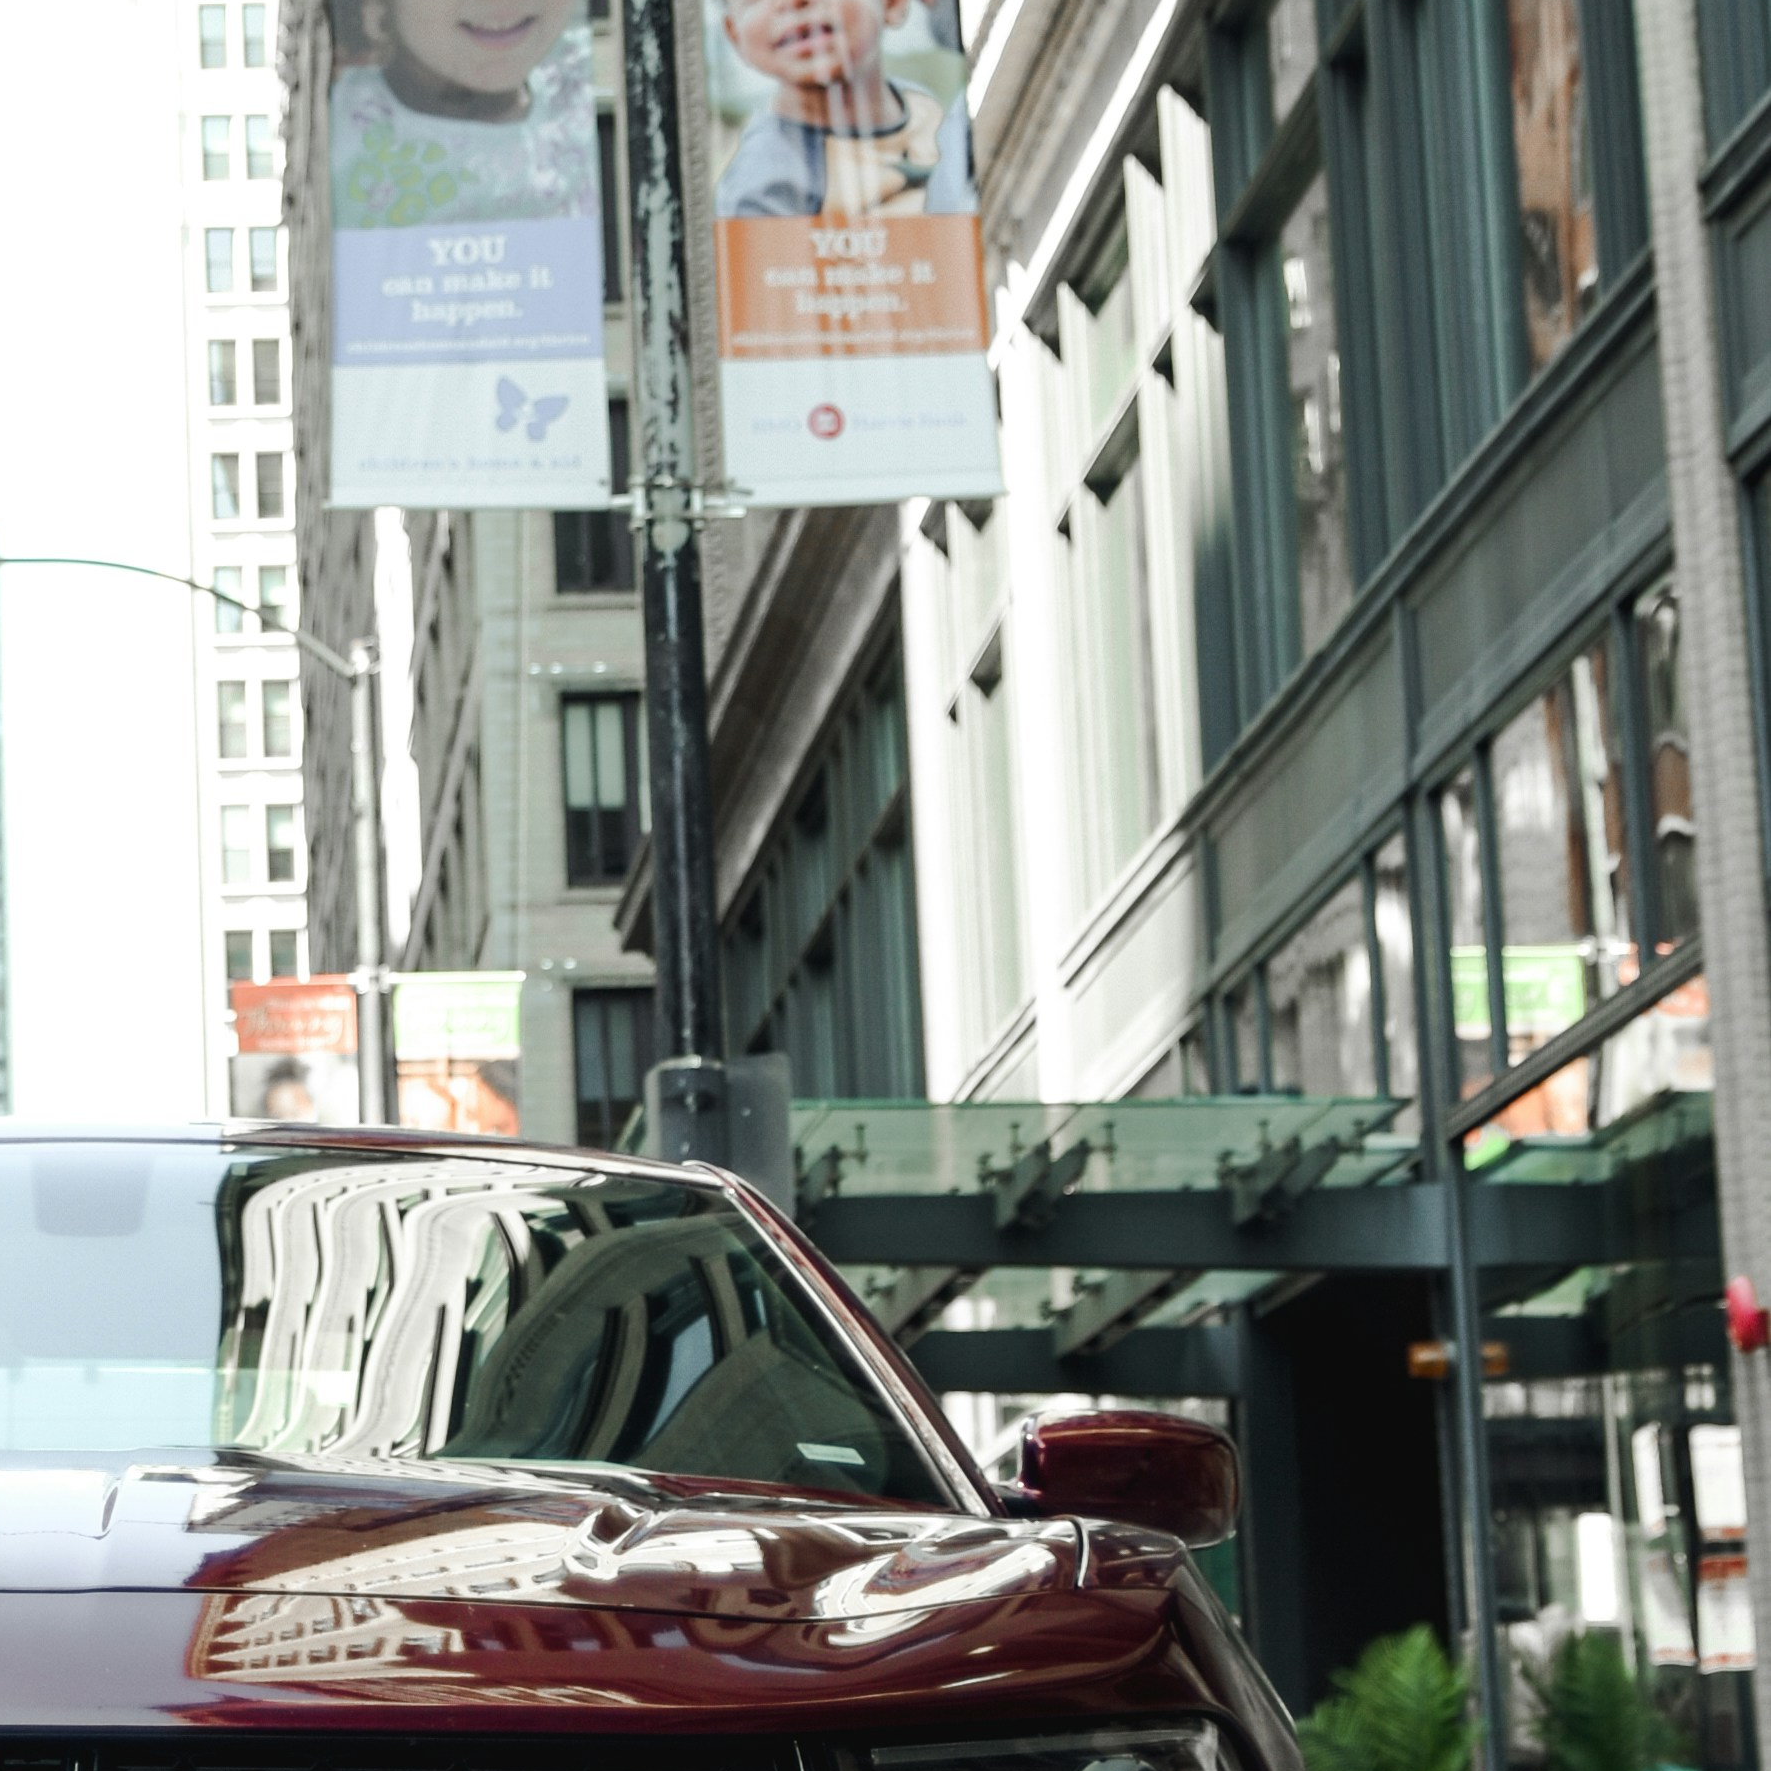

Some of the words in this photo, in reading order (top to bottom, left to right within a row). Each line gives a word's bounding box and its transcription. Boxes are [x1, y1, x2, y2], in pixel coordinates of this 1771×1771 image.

[428, 234, 508, 266] YOU
[810, 229, 886, 259] YOU
[382, 276, 433, 298] can
[442, 267, 523, 294] make
[529, 264, 554, 290] it
[763, 266, 818, 288] can
[824, 260, 906, 286] make
[910, 259, 935, 285] it
[410, 298, 524, 327] happen.
[794, 288, 909, 320] happen.
